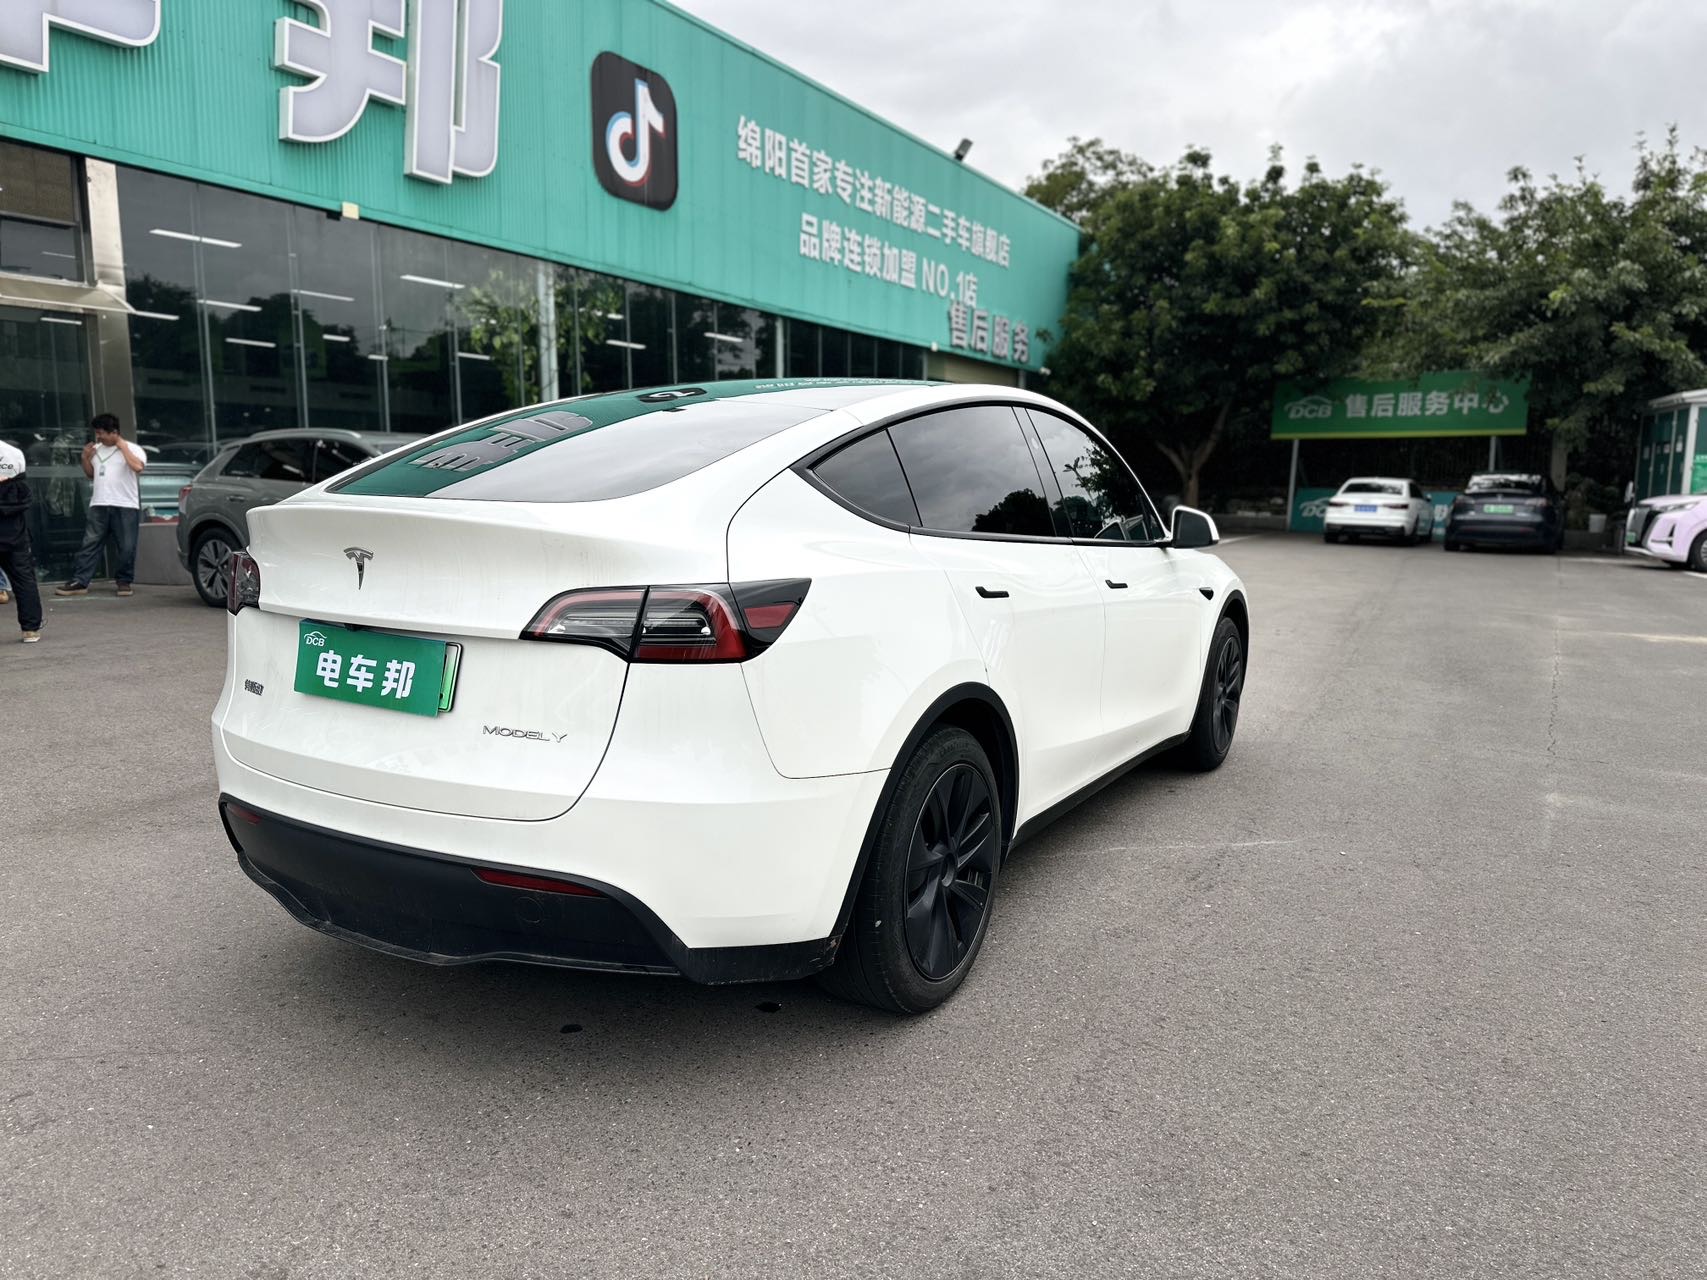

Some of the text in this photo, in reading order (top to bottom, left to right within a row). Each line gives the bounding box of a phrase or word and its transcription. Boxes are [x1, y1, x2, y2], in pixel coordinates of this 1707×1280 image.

[800, 212, 916, 289] 品牌连锁加盟
[949, 300, 1029, 363] 售后服务
[1288, 390, 1510, 419] DCB 售后服务中心
[305, 636, 325, 647] DCB
[316, 649, 416, 699] 电车邦
[482, 725, 568, 743] MODEL Y
